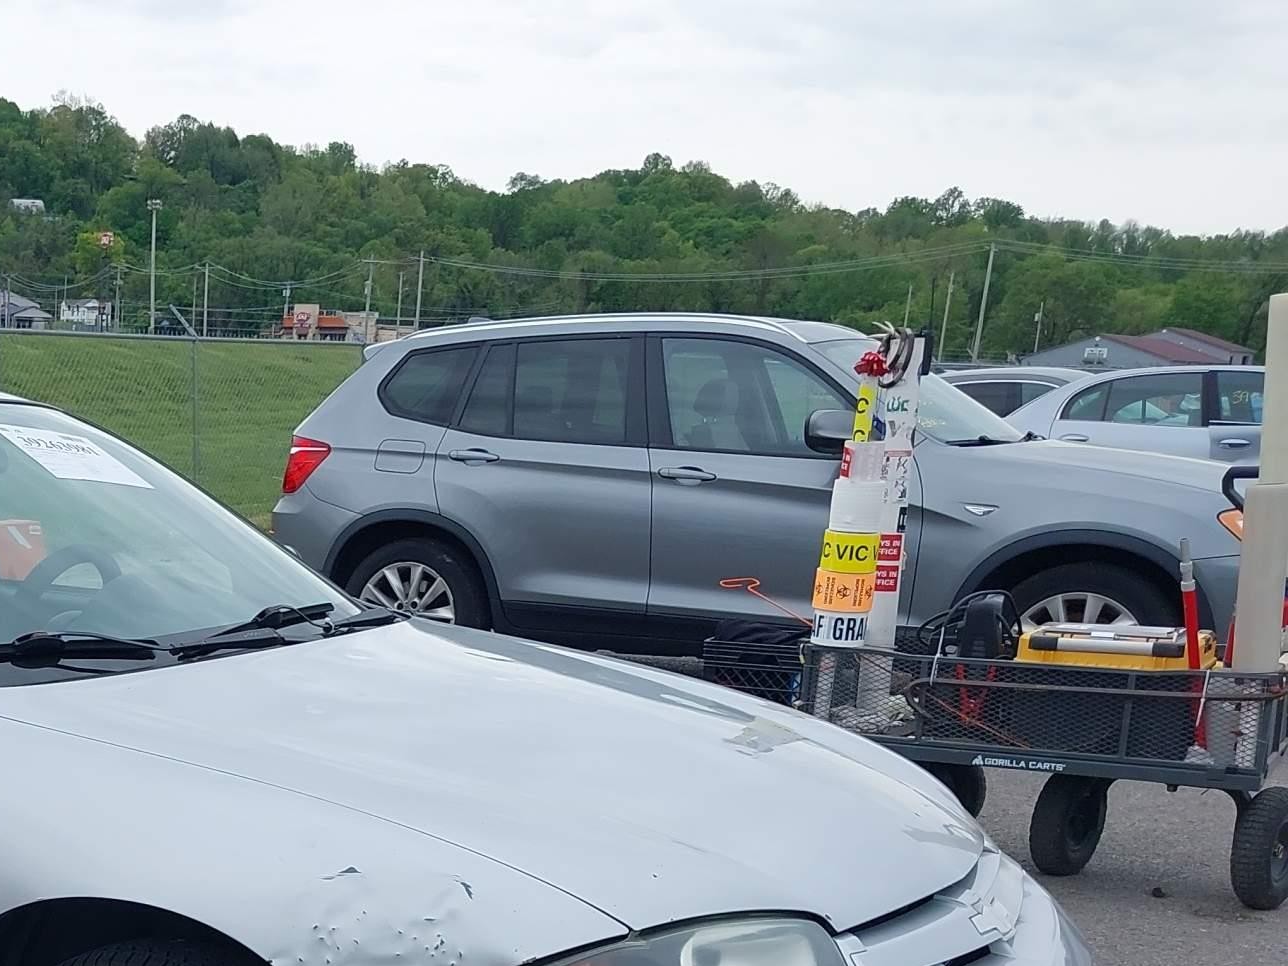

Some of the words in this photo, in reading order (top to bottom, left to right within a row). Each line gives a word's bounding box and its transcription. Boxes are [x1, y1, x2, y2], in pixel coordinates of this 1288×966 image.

[836, 543, 869, 562] VIC
[984, 757, 1026, 768] GORILLA
[1028, 761, 1064, 771] CARTS
